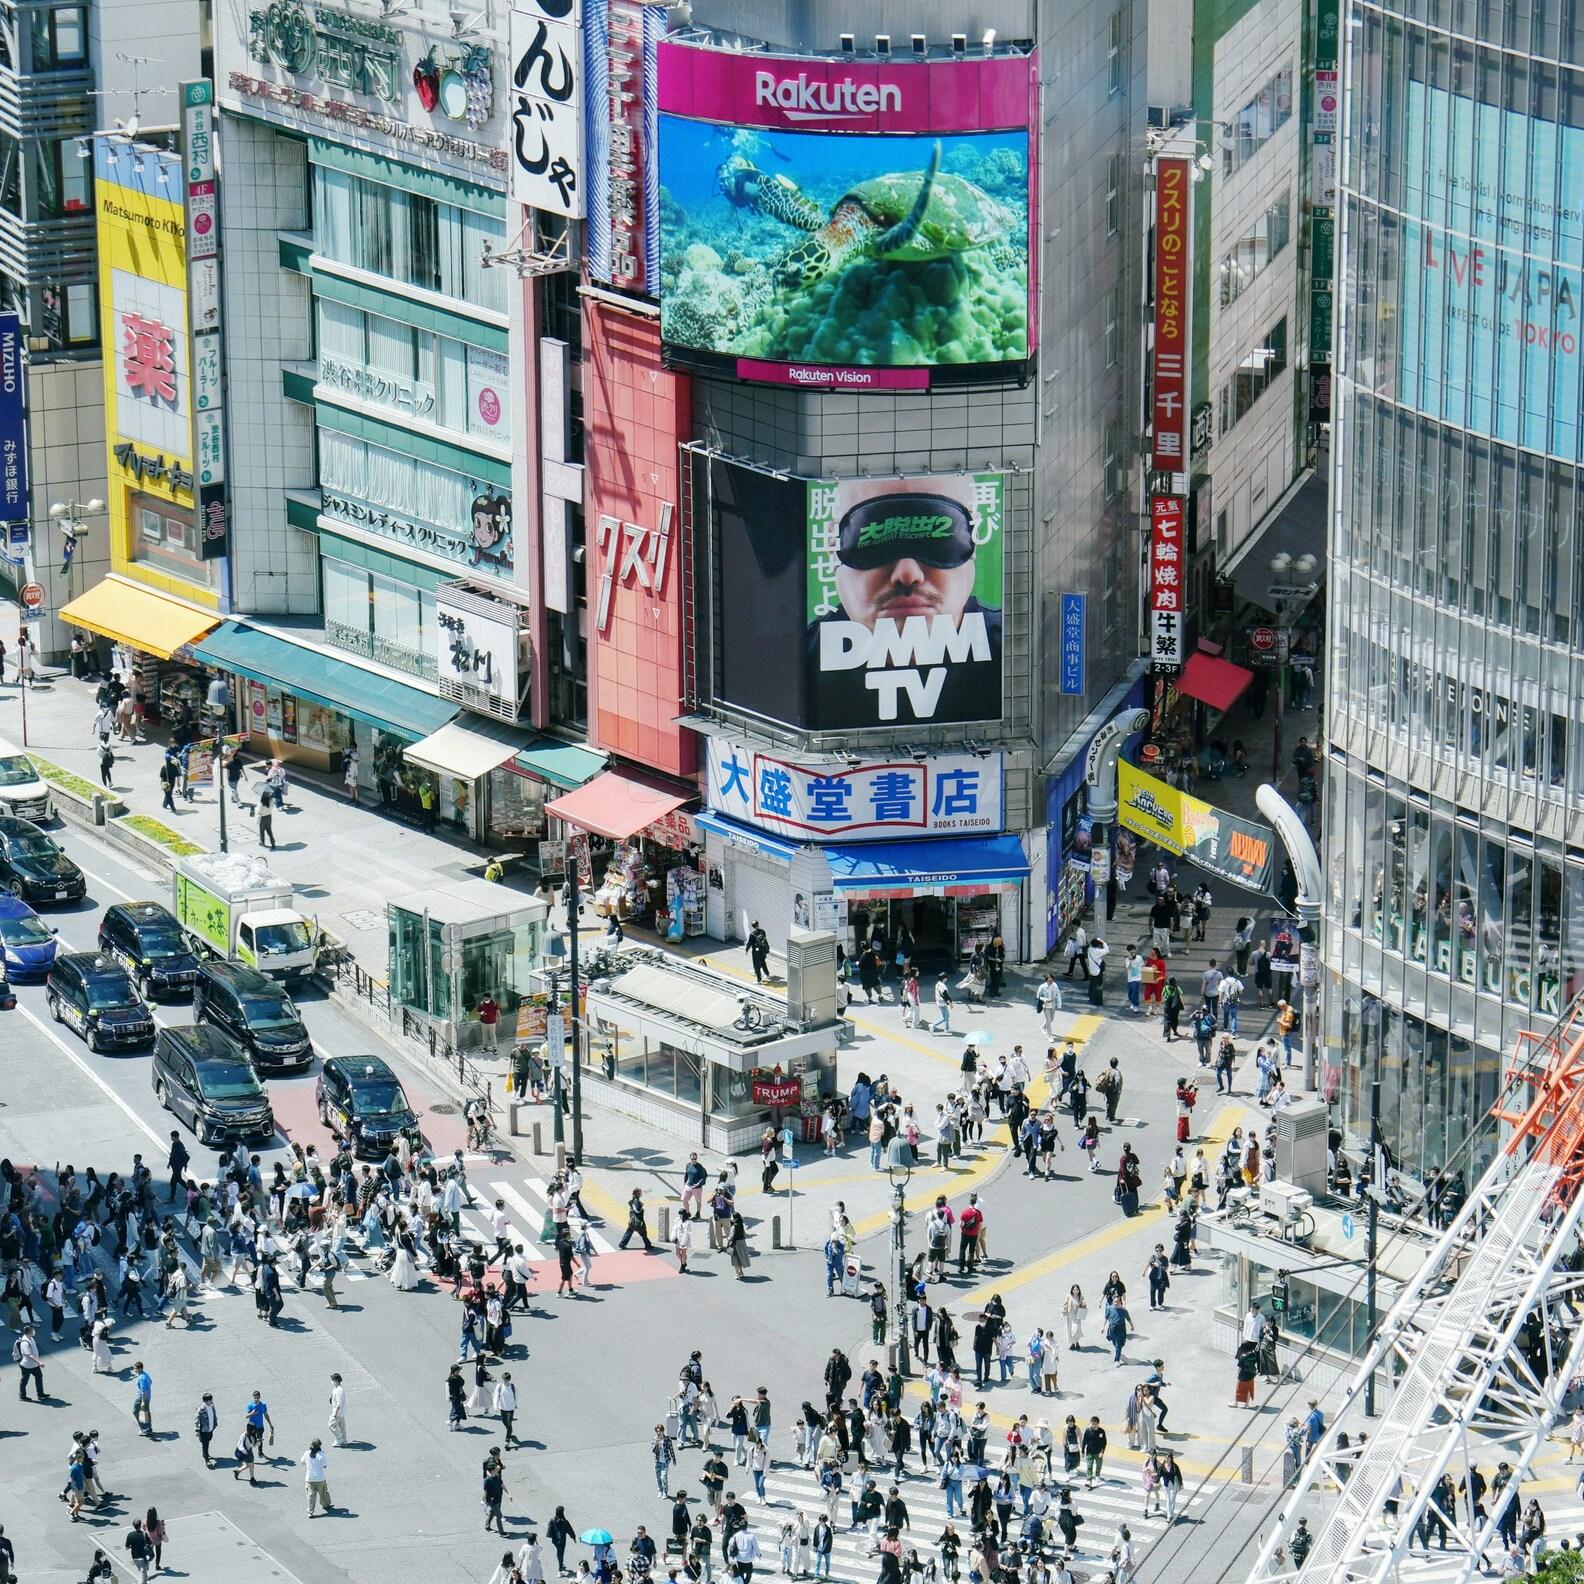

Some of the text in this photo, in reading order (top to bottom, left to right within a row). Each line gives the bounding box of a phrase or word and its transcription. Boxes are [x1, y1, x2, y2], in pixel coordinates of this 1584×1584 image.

[513, 0, 577, 208] んじゃ
[756, 71, 902, 113] Rakuten
[103, 199, 161, 231] Matsumoto
[1161, 168, 1183, 339] クスリのことなら
[2, 332, 16, 393] MIZUHO
[121, 311, 178, 402] 薬
[1515, 319, 1576, 354] TOKYO
[208, 349, 219, 386] フルーツ
[788, 367, 872, 384] Rakuten Vision
[1156, 353, 1183, 457] 三千里
[3, 439, 19, 504] みずほ銀行
[200, 431, 210, 469] フルーツ
[859, 514, 957, 544] 大脱出2
[969, 480, 1002, 545] 再び
[595, 501, 676, 632] クスリ
[809, 486, 843, 617] 脱出せよ
[1154, 518, 1179, 610] 七輪焼肉
[819, 612, 993, 672] DMM
[1065, 599, 1082, 690] 大盛堂商事ビル
[1155, 611, 1177, 657] 牛繁
[865, 667, 949, 721] TV
[720, 753, 981, 823] 大盛堂書店
[728, 832, 761, 849] TAISEIDO
[933, 817, 991, 830] BOOKS TAISEIDO
[907, 873, 958, 884] TAISEIDO
[754, 1084, 798, 1100] TRUMP
